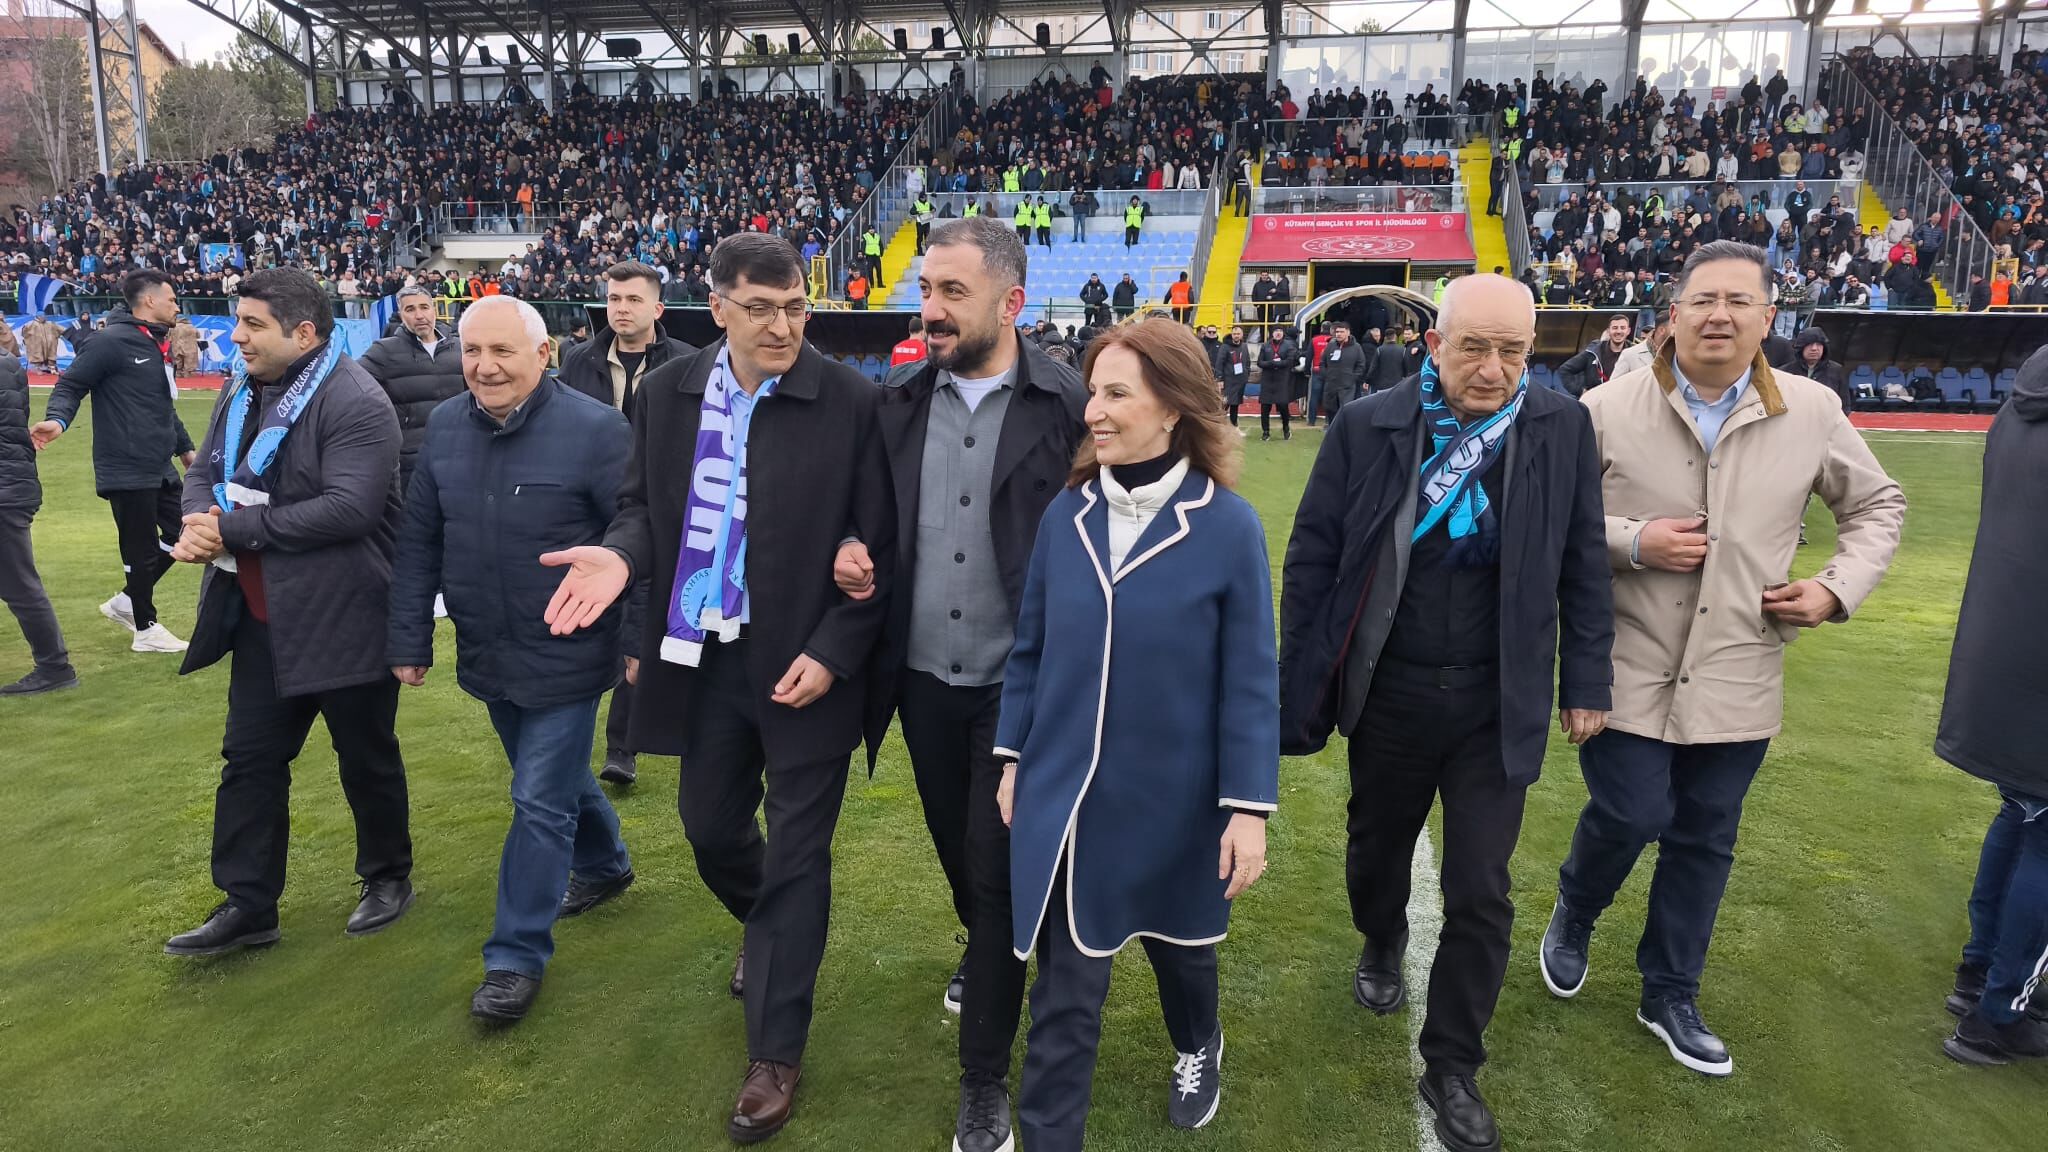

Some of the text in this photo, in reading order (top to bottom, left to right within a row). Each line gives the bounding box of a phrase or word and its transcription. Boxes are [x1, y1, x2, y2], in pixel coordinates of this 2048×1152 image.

[1284, 219, 1314, 228] KÜTAHYA
[1316, 218, 1344, 229] GENÇLİK
[1345, 219, 1354, 228] VE
[1355, 219, 1374, 228] SPOR
[1383, 217, 1427, 227] MÜDÜRLÜĞÜ
